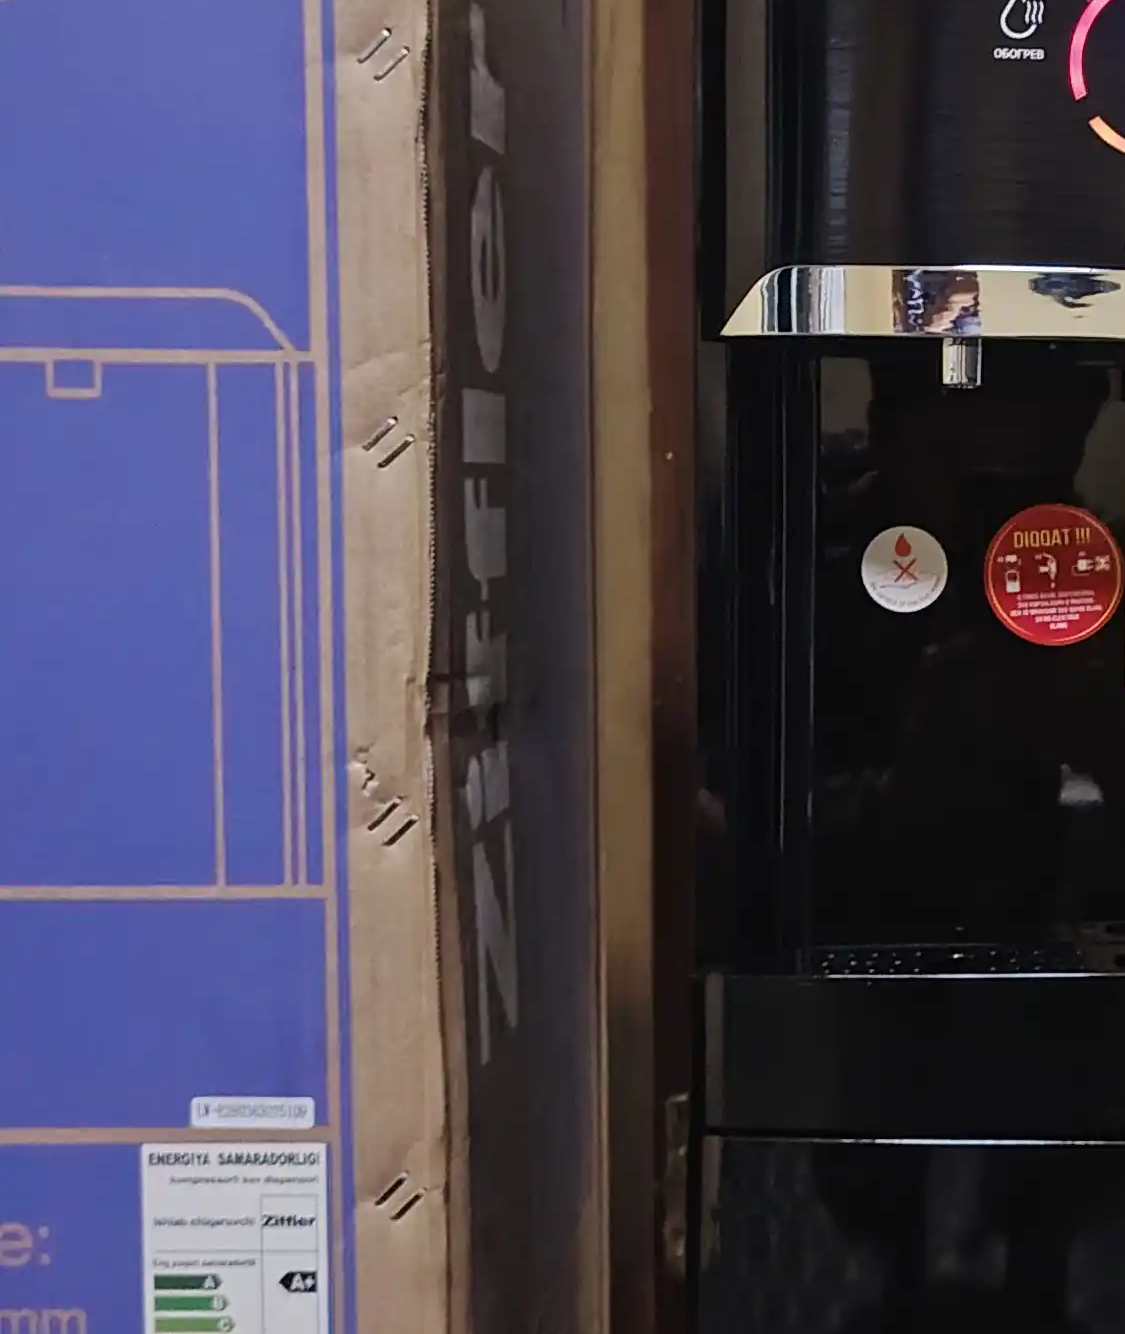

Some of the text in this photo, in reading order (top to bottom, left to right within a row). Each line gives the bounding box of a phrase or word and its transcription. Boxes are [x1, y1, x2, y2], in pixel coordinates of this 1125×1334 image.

[993, 47, 1045, 60] ОБОГРЕВ
[148, 1153, 320, 1167] ENERGIYA SAMARADORLIGI
[203, 1274, 217, 1289] A
[290, 1272, 316, 1291] A+
